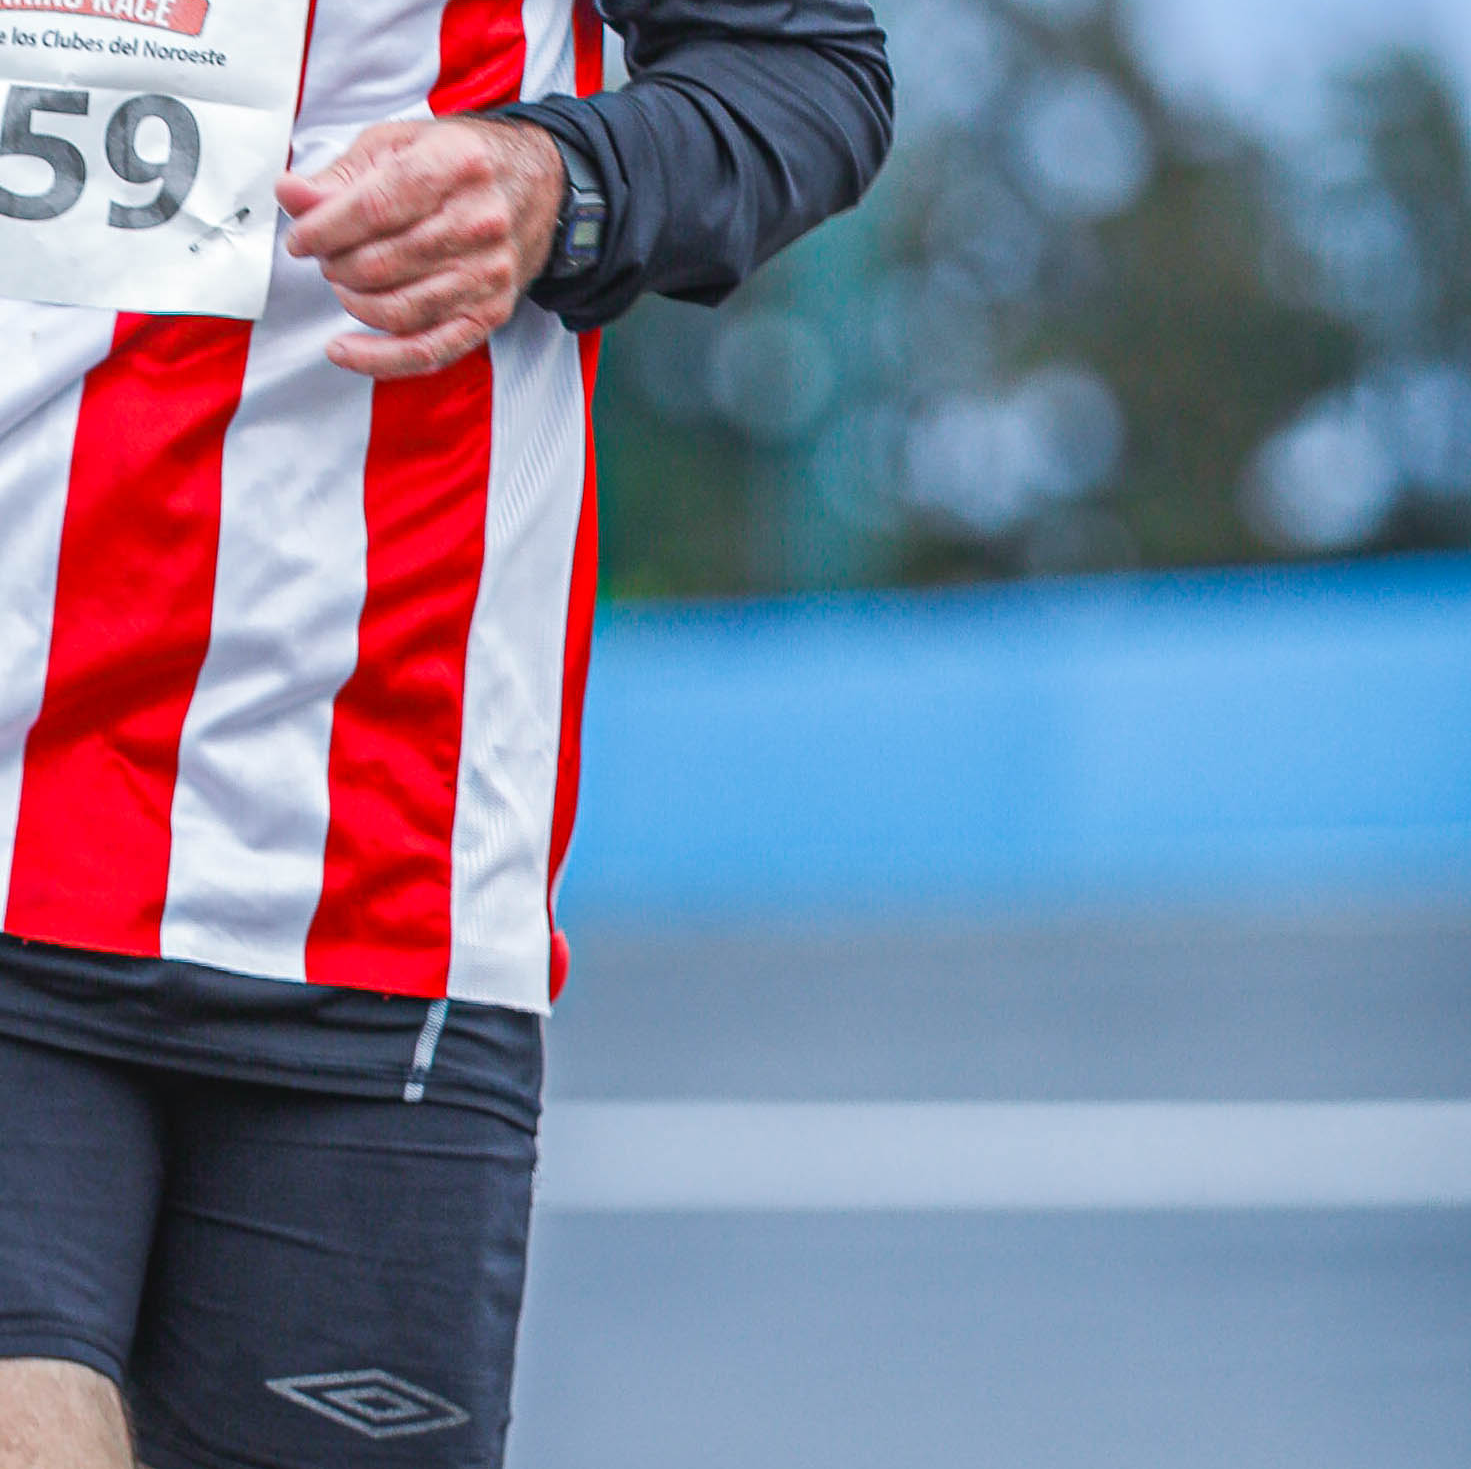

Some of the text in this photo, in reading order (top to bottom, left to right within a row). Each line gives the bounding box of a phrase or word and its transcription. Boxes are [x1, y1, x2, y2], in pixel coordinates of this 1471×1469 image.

[12, 26, 36, 46] los
[42, 29, 104, 52] Clubes
[109, 36, 138, 56] del
[143, 39, 227, 66] Noroeste
